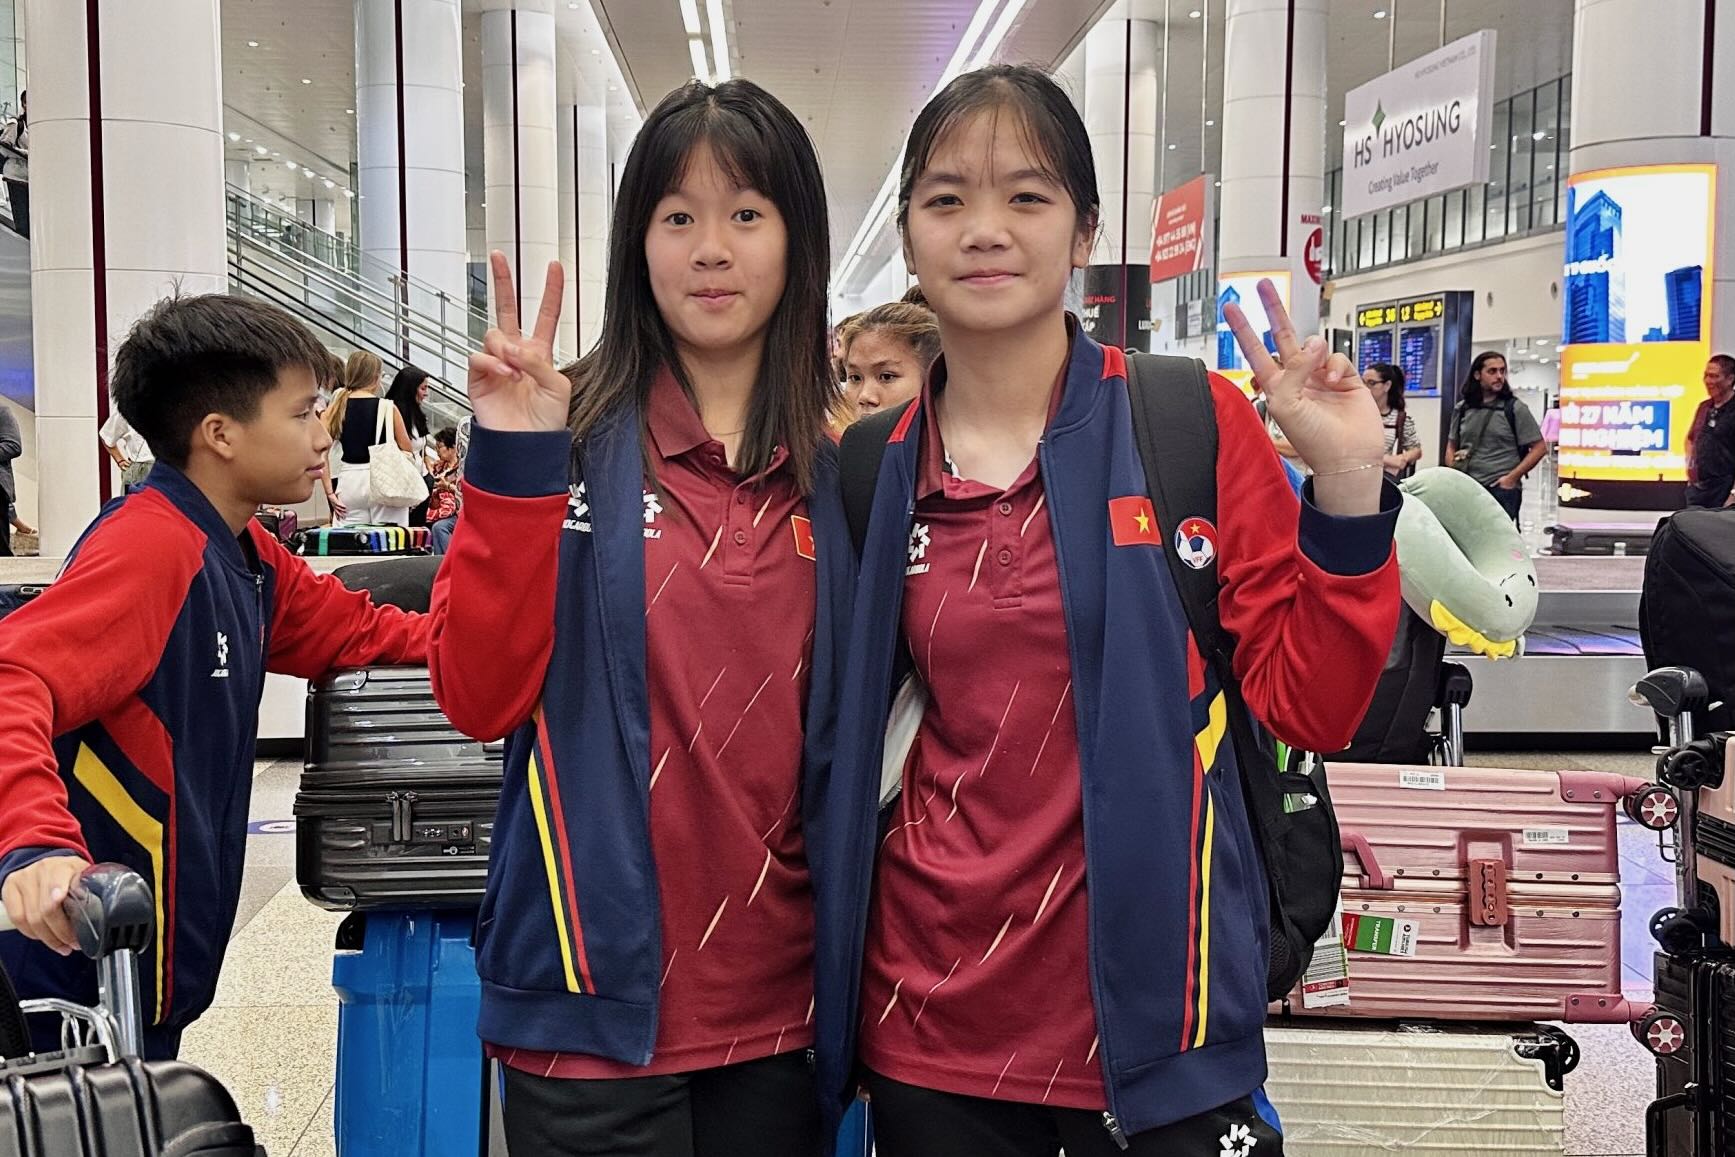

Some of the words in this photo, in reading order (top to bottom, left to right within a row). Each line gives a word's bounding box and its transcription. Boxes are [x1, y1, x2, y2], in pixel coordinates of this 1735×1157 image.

[1354, 135, 1372, 168] HS
[1383, 100, 1461, 158] HYOSUNG
[1368, 176, 1393, 195] Creating
[1393, 168, 1410, 187] Value
[1411, 160, 1440, 184] Together
[1602, 401, 1655, 425] NĂM
[1371, 920, 1382, 951] TRANSFER
